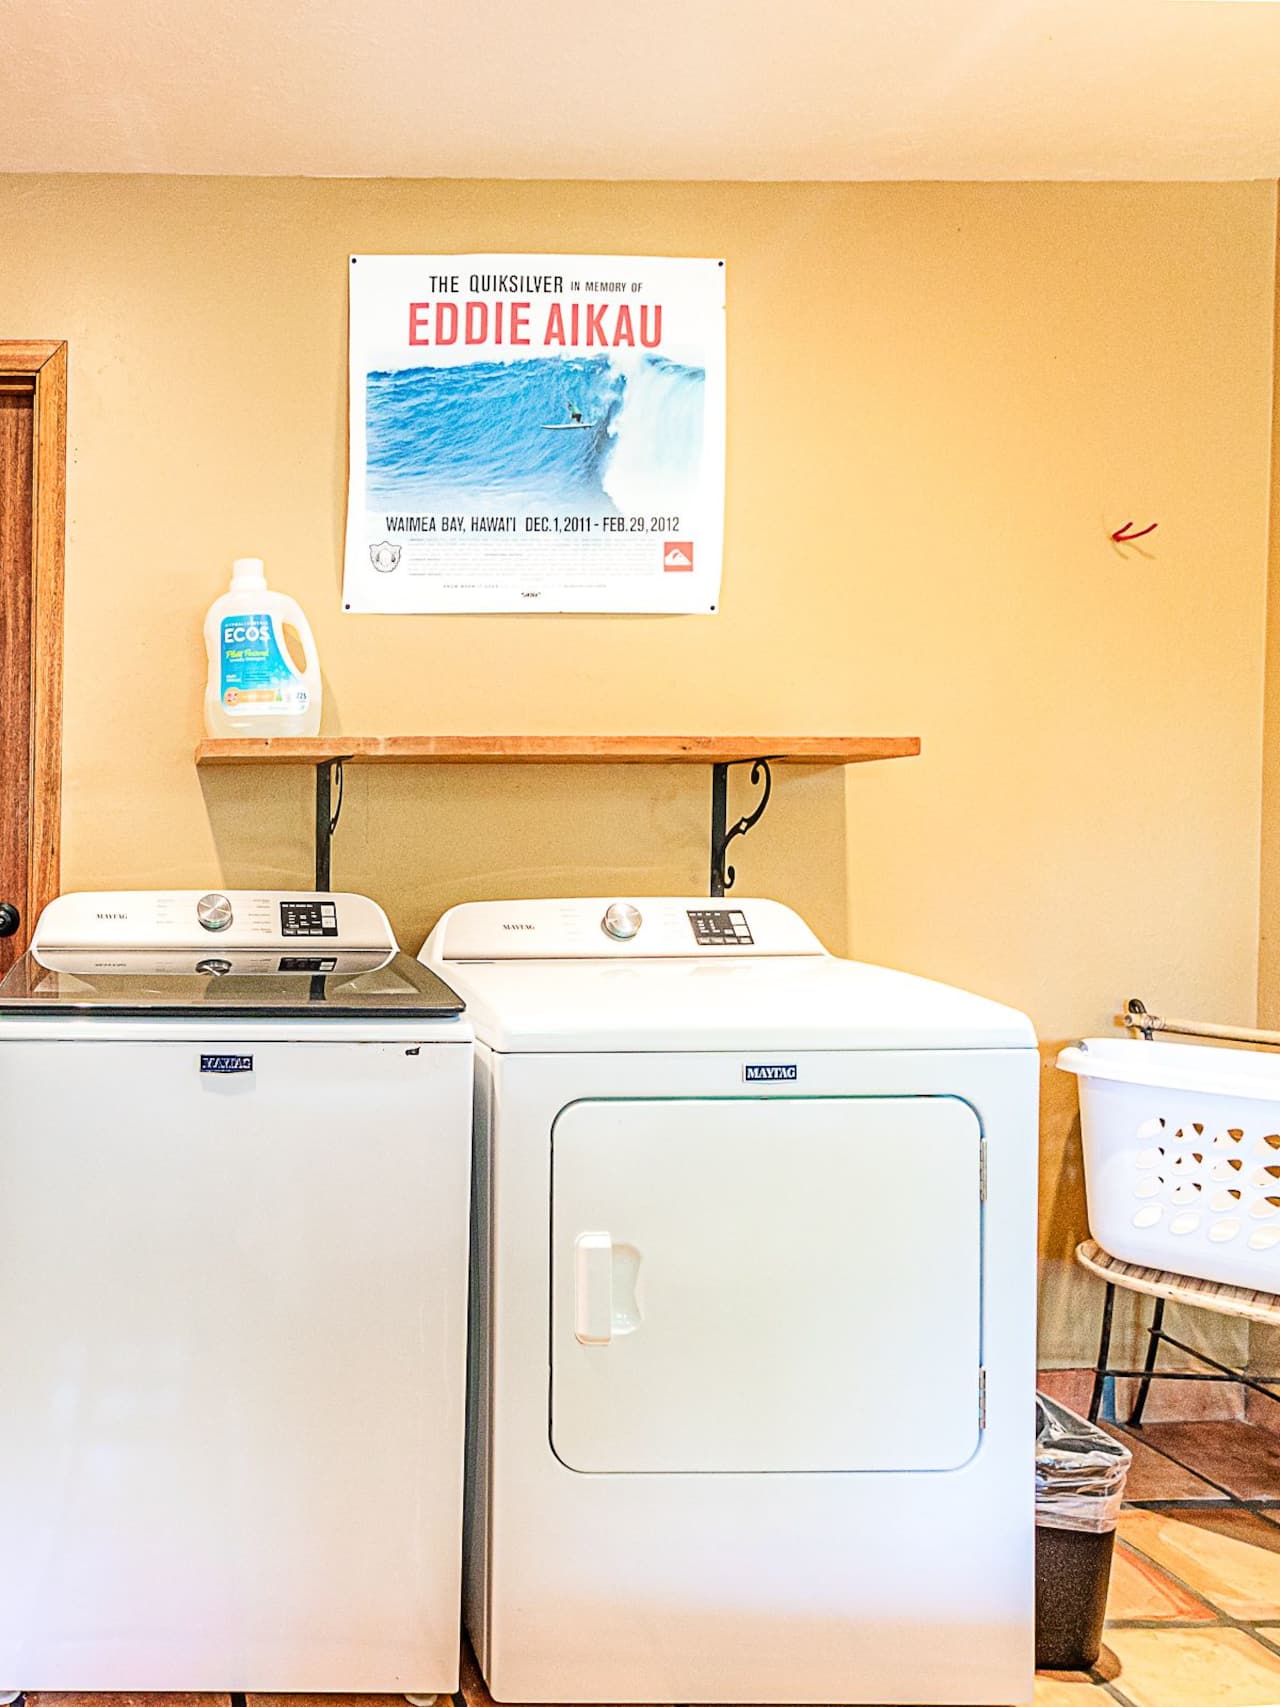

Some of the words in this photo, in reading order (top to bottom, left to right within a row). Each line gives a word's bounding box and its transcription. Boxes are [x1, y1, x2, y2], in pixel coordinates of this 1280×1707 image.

[429, 275, 459, 293] THE
[469, 274, 563, 293] QUIKSILVER
[570, 281, 580, 291] IN
[585, 281, 626, 292] MEMORY
[631, 282, 643, 292] OF
[409, 301, 530, 346] EDDIE
[544, 302, 663, 348] AIKAU
[386, 516, 436, 531] WAIMEA
[441, 516, 466, 533] BAY,
[224, 626, 270, 643] ECOS
[747, 1067, 796, 1079] MAYTAG
